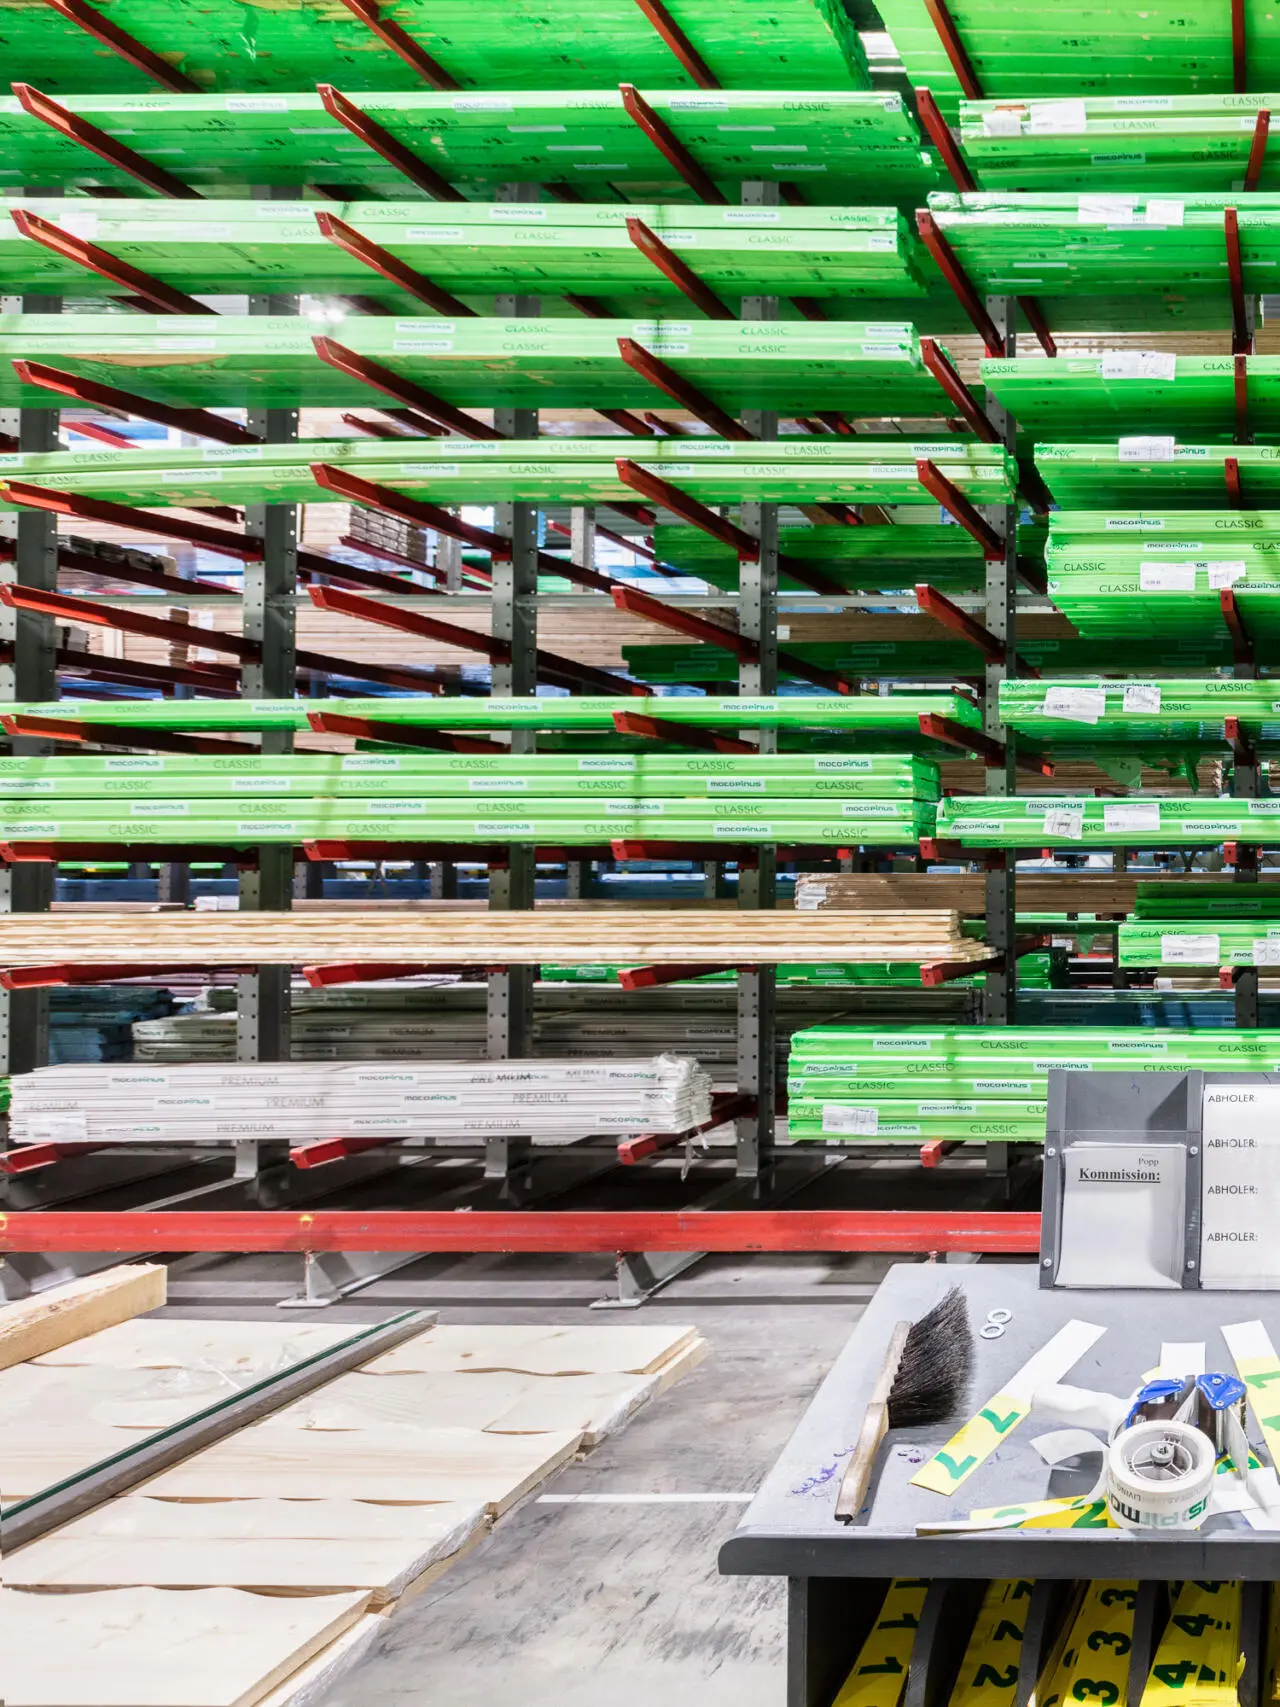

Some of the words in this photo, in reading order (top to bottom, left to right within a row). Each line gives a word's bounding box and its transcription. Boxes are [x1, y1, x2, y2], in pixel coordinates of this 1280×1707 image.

[1222, 96, 1270, 107] CLASSIC
[505, 324, 554, 335] CLASSIC
[741, 326, 789, 336] CLASSIC
[738, 344, 787, 354] CLASSIC
[913, 444, 964, 453] mocopinus
[73, 452, 121, 464] CLASSIC
[1215, 519, 1263, 529] CLASSIC
[1205, 682, 1254, 692] CLASSIC
[722, 702, 775, 711] mocopinus
[108, 759, 161, 767] mocopinus
[213, 758, 261, 770] CLASSIC
[450, 759, 497, 769] CLASSIC
[582, 759, 633, 767] mocopinus
[687, 759, 735, 771] CLASSIC
[818, 759, 869, 768] mocopinus
[709, 779, 762, 788] mocopinus
[816, 780, 863, 791] CLASSIC
[3, 804, 50, 815] CLASSIC
[714, 803, 762, 815] CLASSIC
[4, 824, 56, 833] mocopinus
[109, 824, 157, 835] CLASSIC
[1185, 822, 1237, 831] mocopinus
[822, 827, 868, 839] CLASSIC
[980, 1041, 1028, 1050] CLASSIC
[1218, 1044, 1267, 1054] CLASSIC
[848, 1081, 895, 1090] CLASSIC
[970, 1124, 1018, 1134] CLASSIC
[1207, 1139, 1258, 1149] ABHOLER:
[1138, 1157, 1159, 1167] Popp
[1078, 1168, 1161, 1183] Kommission:
[1207, 1185, 1258, 1195] ABHOLER:
[1207, 1232, 1258, 1243] ABHOLER:
[979, 1408, 1020, 1434] 7
[935, 1452, 976, 1480] 7
[1100, 1588, 1137, 1611] 3
[877, 1613, 919, 1631] 1
[1171, 1613, 1215, 1638] 4
[1087, 1630, 1131, 1656] 3
[858, 1656, 903, 1676] 1
[972, 1663, 1018, 1688] 2
[1153, 1660, 1197, 1689] 4
[1072, 1678, 1119, 1707] 3
